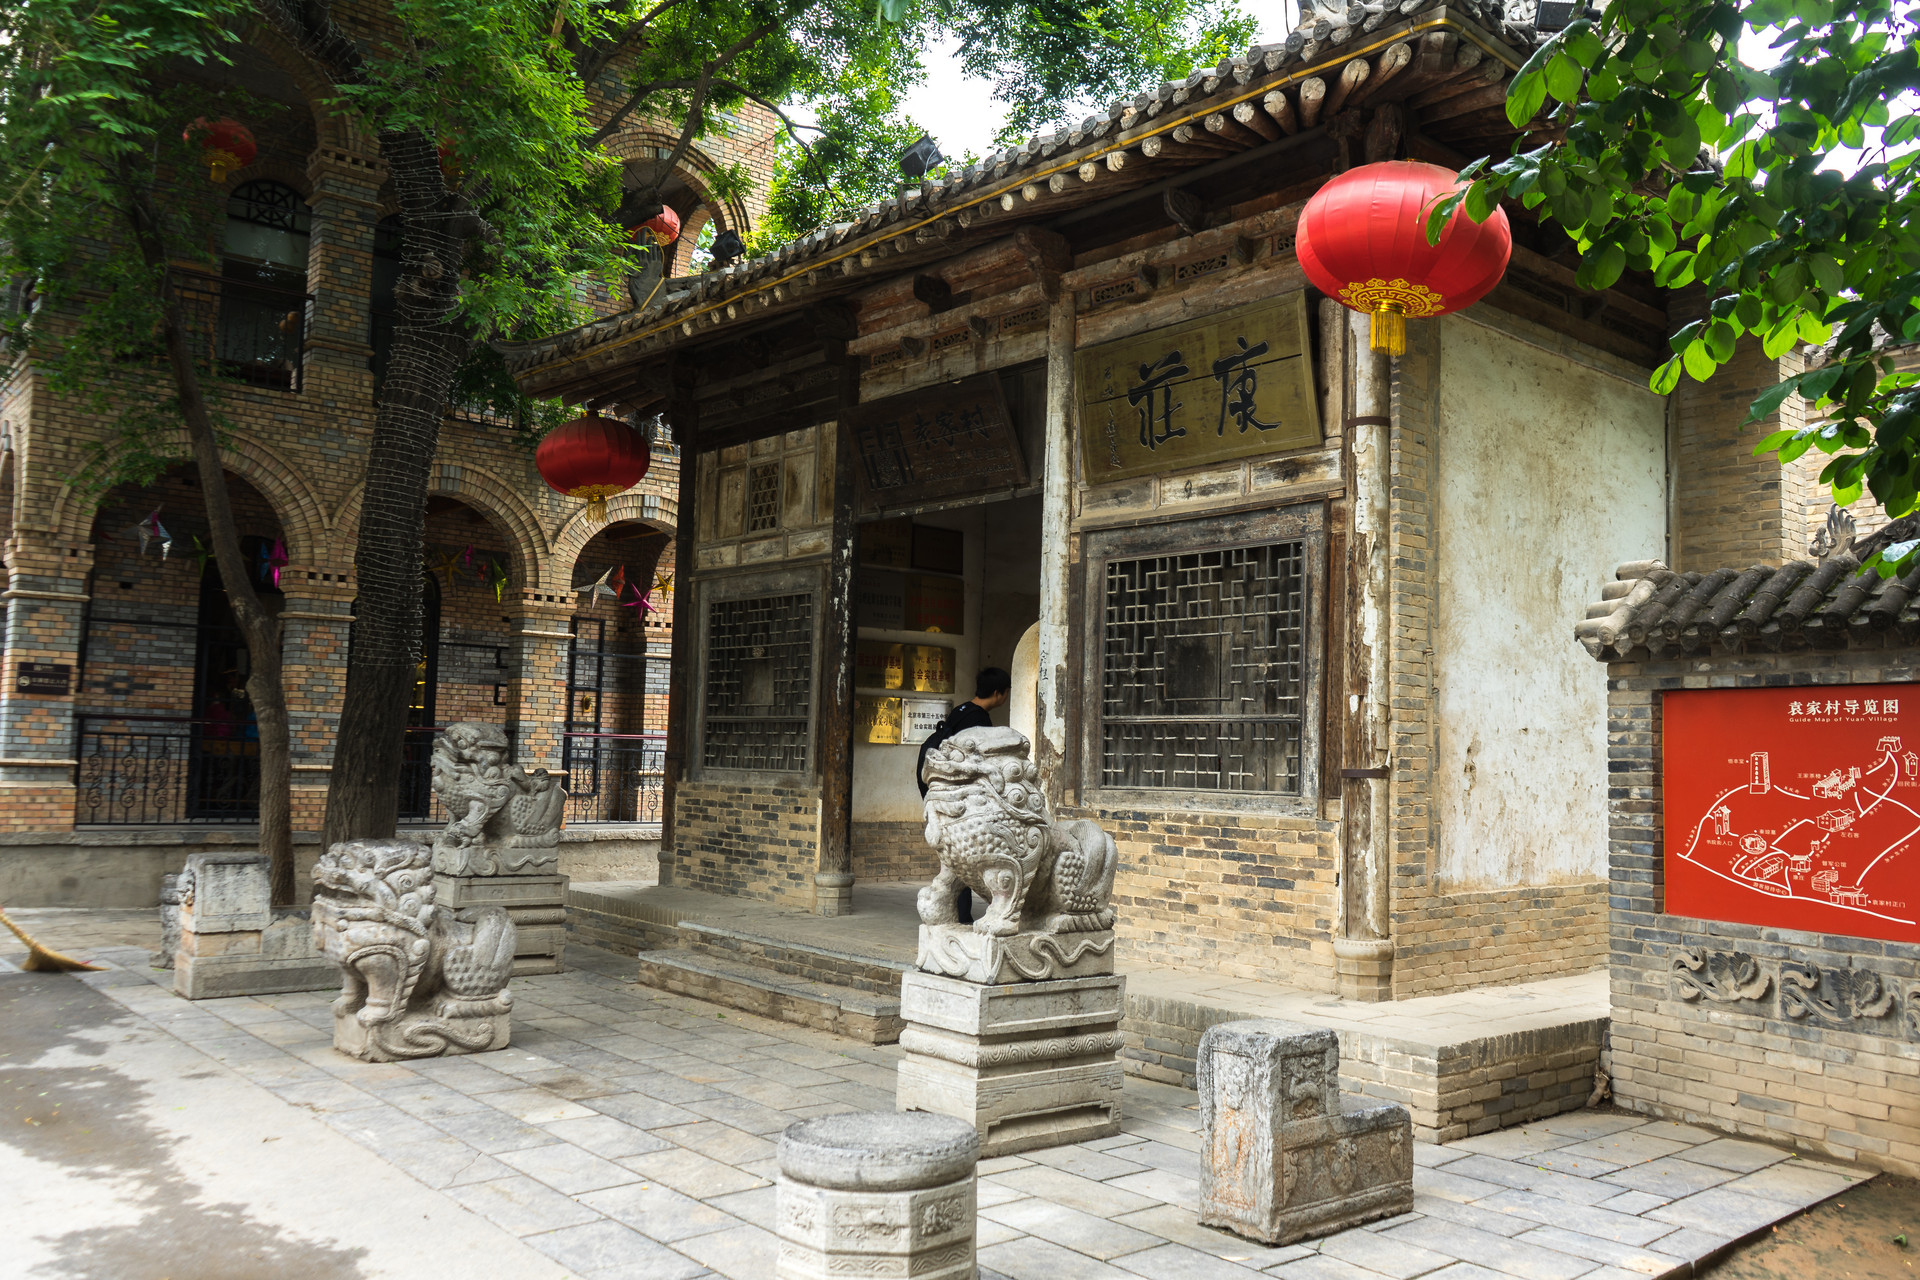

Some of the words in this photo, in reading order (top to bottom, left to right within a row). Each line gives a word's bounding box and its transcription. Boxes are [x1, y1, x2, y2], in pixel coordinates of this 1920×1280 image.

[912, 403, 990, 451] 袁家村
[1788, 699, 1899, 716] 袁家村导览图
